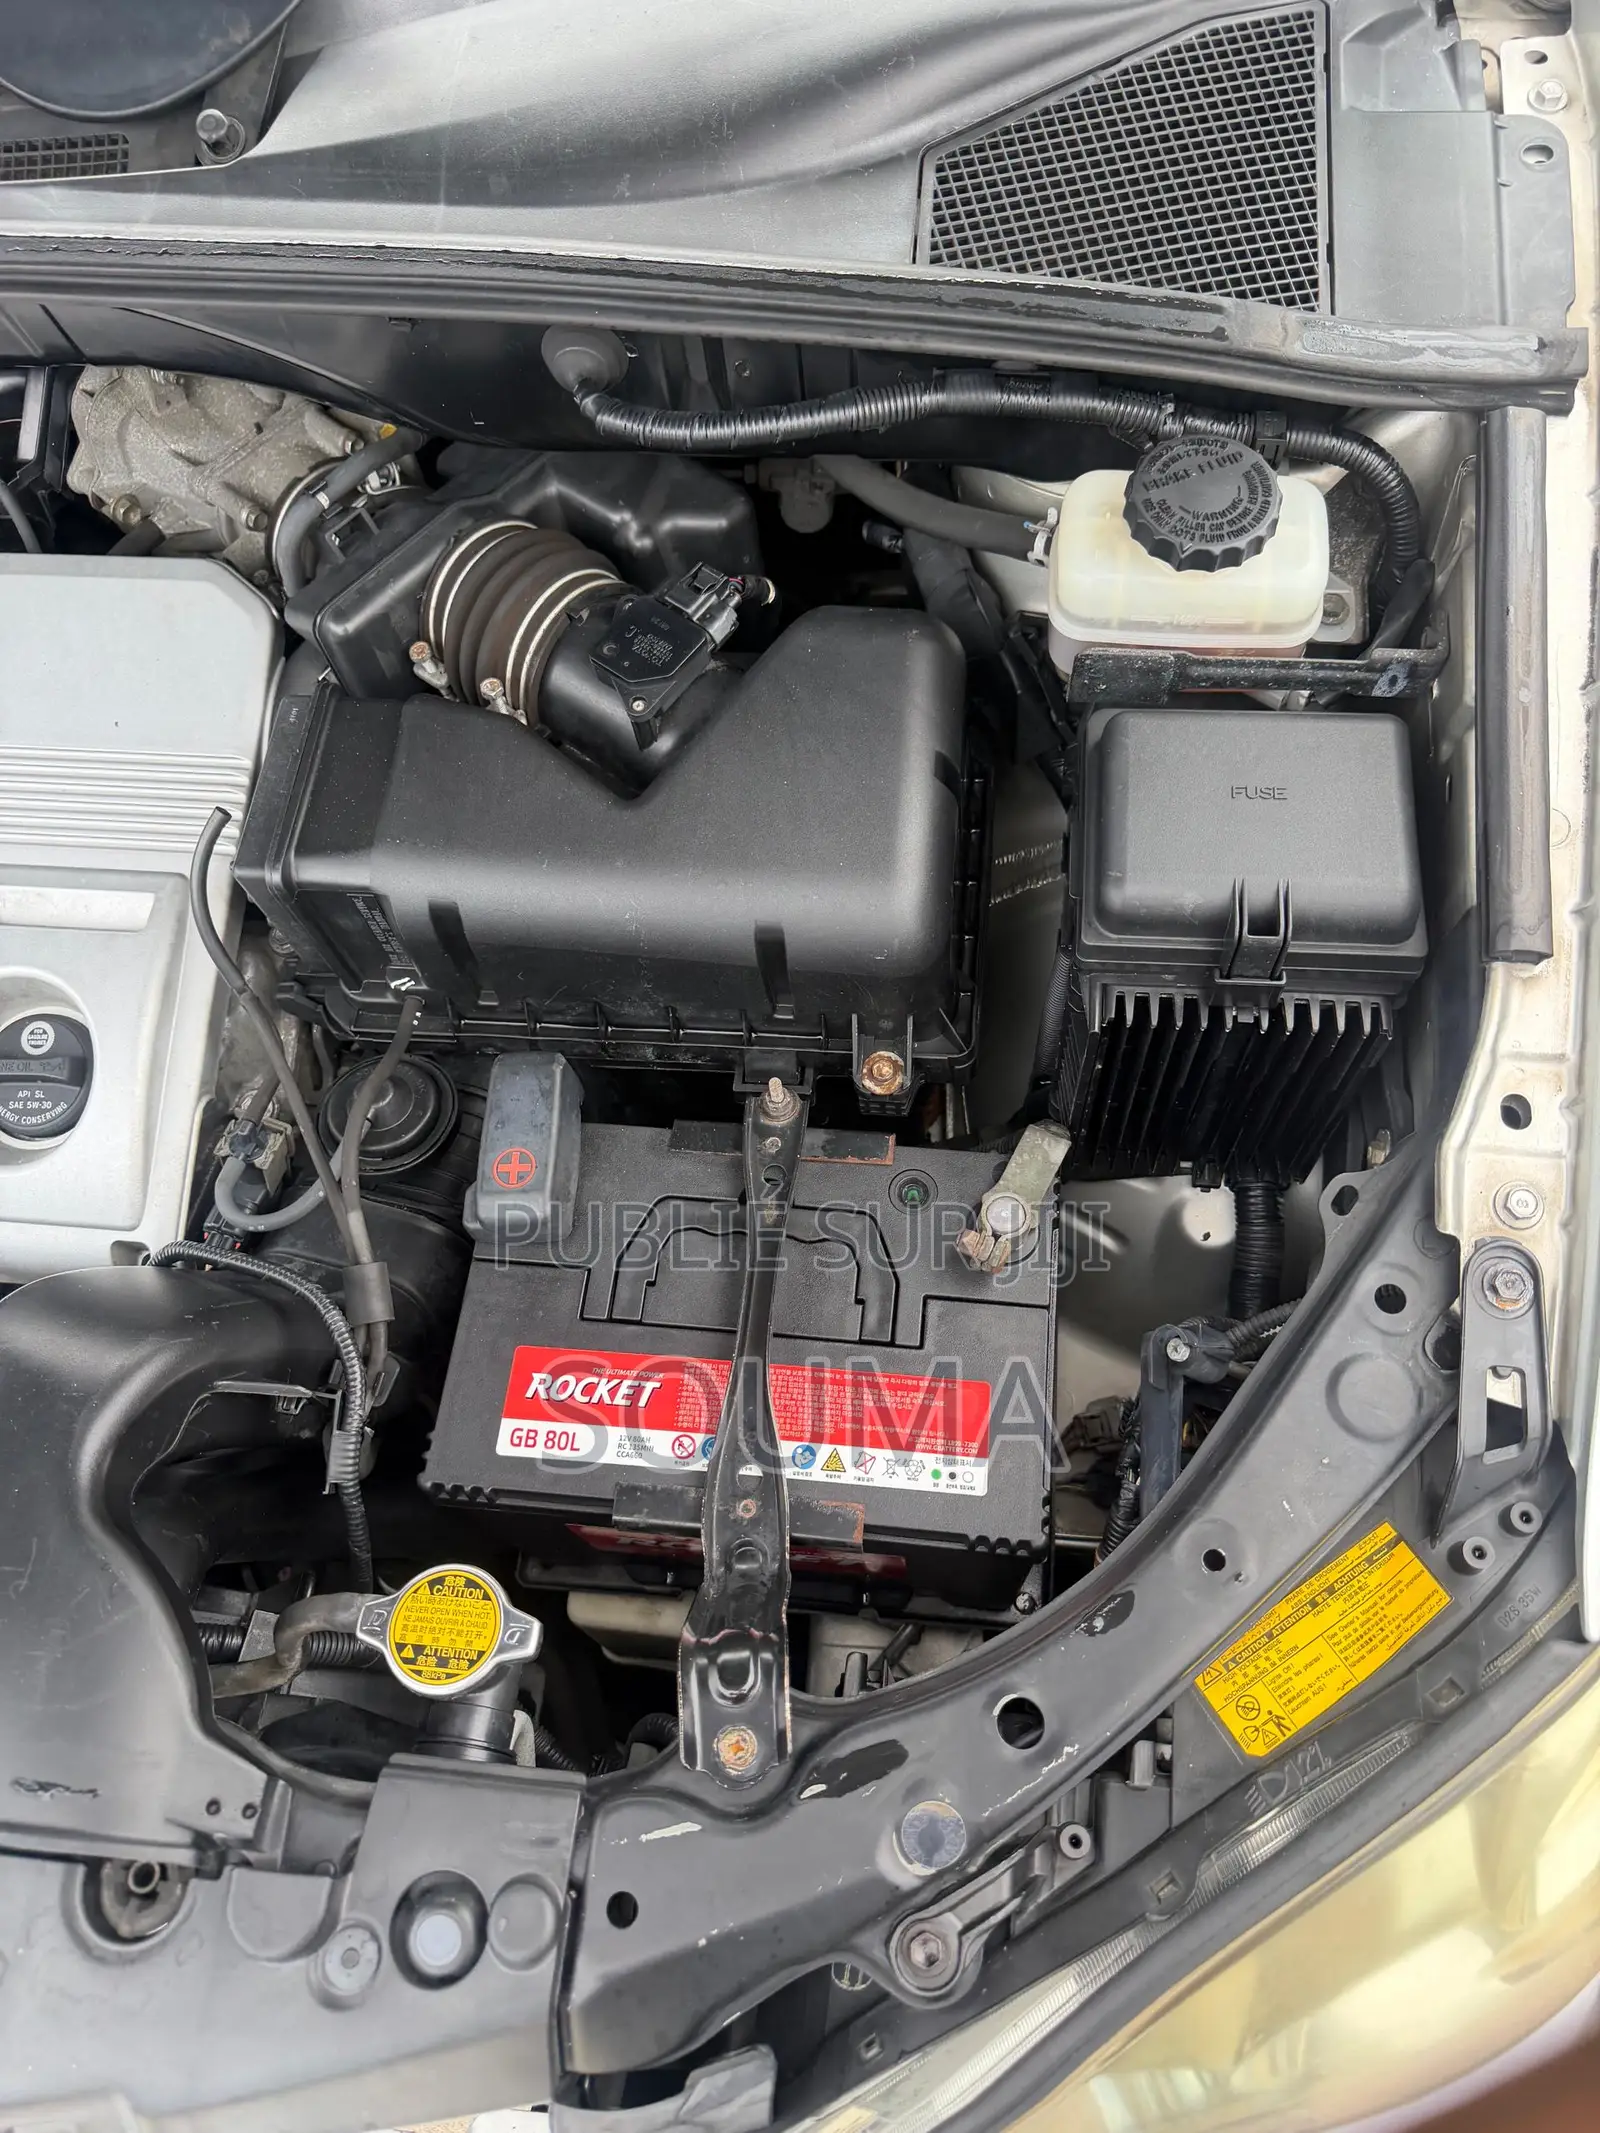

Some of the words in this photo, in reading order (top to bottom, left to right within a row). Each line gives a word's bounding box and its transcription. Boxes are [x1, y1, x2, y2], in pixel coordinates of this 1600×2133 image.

[1231, 786, 1288, 800] FUSE
[17, 1090, 31, 1098] API
[35, 1090, 45, 1098] SL
[9, 1101, 24, 1109] SAE
[27, 1101, 52, 1109] 5W-30
[21, 1101, 68, 1125] CONSERVING
[604, 1368, 638, 1376] ULTIMATE
[638, 1370, 664, 1379] POWER
[525, 1372, 662, 1408] ROCKET
[509, 1427, 538, 1448] GB
[543, 1429, 581, 1451] 80L
[617, 1442, 627, 1450] RC
[618, 1434, 632, 1442] 12V
[1313, 1553, 1349, 1583] CROISEMENT
[433, 1585, 484, 1600] CAUTION
[1289, 1577, 1331, 1611] ABBLENDLICHT
[1311, 1600, 1331, 1618] HAUTE
[1330, 1582, 1356, 1603] TENSION
[405, 1606, 429, 1615] NEVER
[430, 1607, 450, 1616] OPEN
[452, 1609, 474, 1618] WHEN
[1235, 1635, 1269, 1663] CAUTION
[1270, 1602, 1312, 1637] ATTENTION
[1332, 1560, 1369, 1591] ACHTUNG
[1337, 1613, 1360, 1633] Owner's
[1359, 1599, 1379, 1616] Manual
[402, 1614, 411, 1622] NE
[412, 1615, 434, 1624] JAMAIS
[435, 1616, 459, 1626] OUVRIR
[423, 1646, 478, 1660] ATTENTION
[1222, 1670, 1237, 1684] HIGH
[1237, 1652, 1262, 1673] VOLTAGE
[1262, 1637, 1282, 1654] INSIDE
[1223, 1666, 1269, 1703] HOCHSPANNUNG
[1276, 1643, 1299, 1663] INNERN
[1265, 1671, 1283, 1687] Lights
[1292, 1667, 1302, 1677] les
[1287, 1694, 1311, 1715] Leuchten
